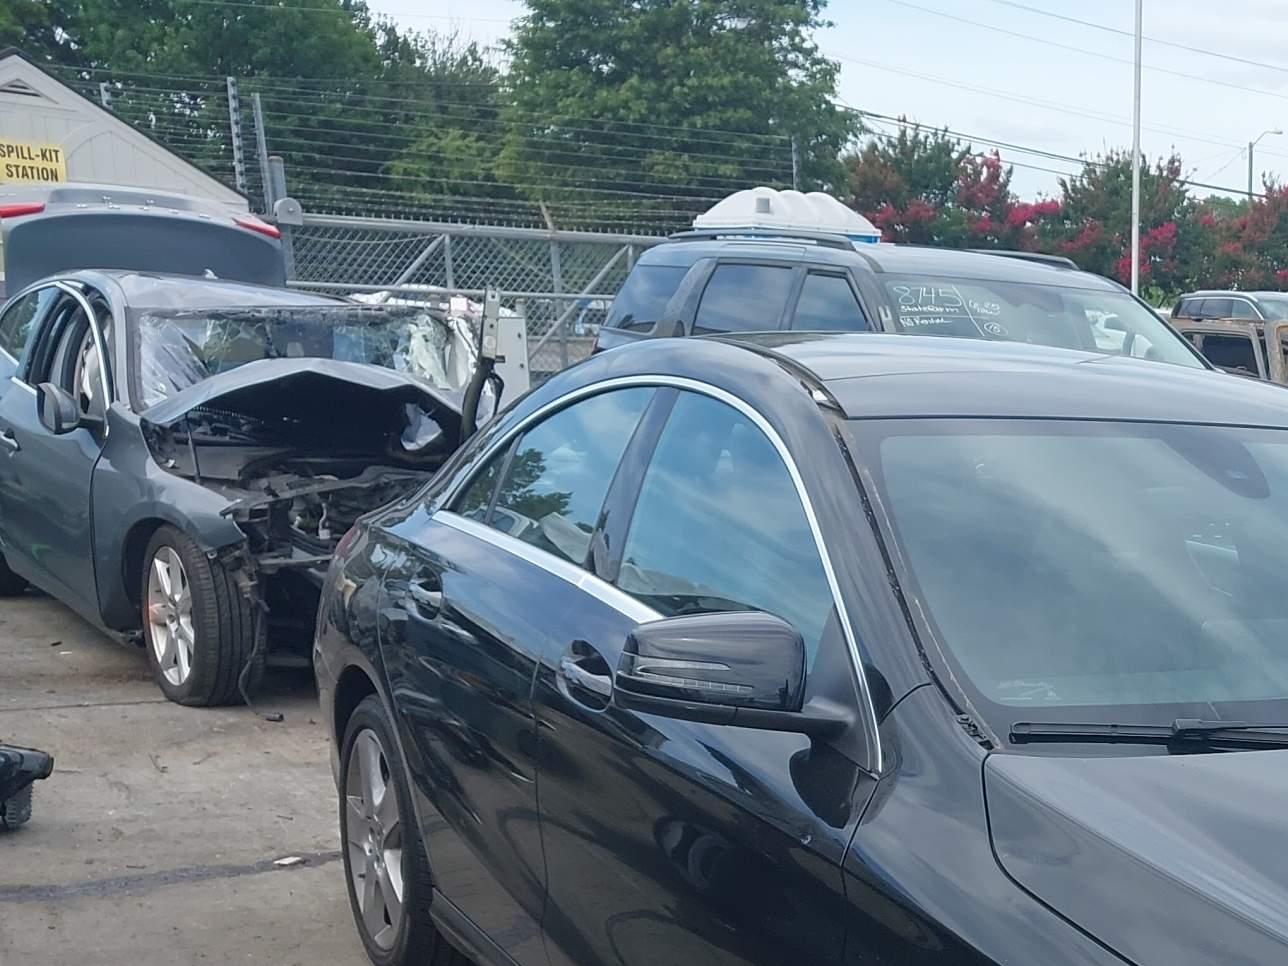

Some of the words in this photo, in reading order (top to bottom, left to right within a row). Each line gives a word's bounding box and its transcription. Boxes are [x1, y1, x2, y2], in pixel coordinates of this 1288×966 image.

[0, 144, 60, 163] SPILL-KIT
[5, 163, 59, 182] STATION
[893, 286, 962, 306] 8745
